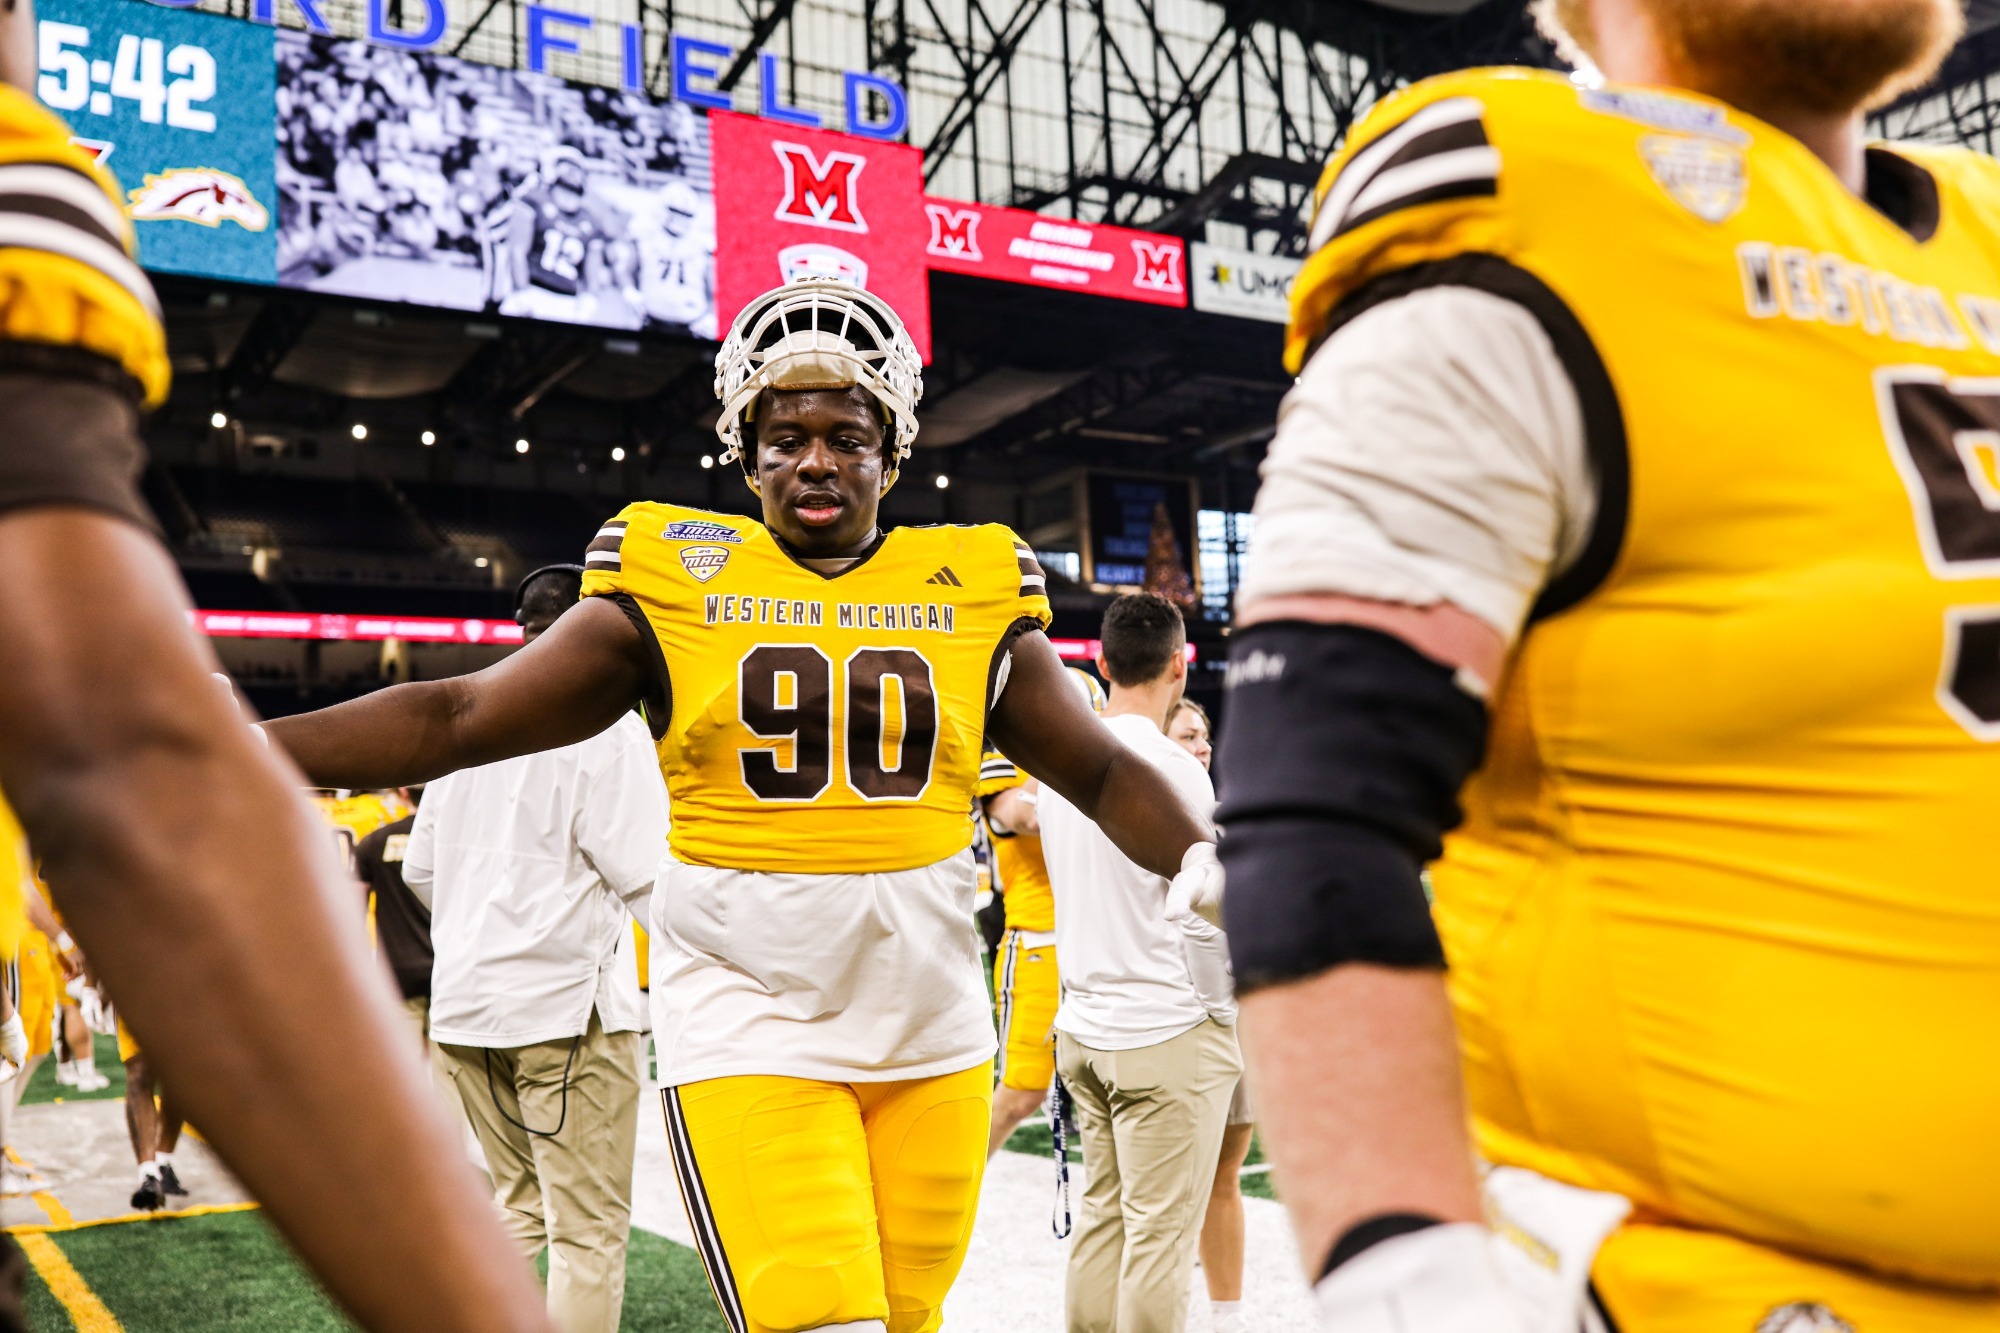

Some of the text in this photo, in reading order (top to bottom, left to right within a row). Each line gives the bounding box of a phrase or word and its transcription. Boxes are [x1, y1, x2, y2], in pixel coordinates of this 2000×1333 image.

[38, 20, 217, 132] 5:42
[527, 4, 908, 139] FIELD
[772, 140, 869, 234] M
[664, 532, 742, 543] CHAMPIONSHIP
[682, 525, 733, 536] MAC
[684, 556, 727, 568] MAC
[704, 594, 955, 634] WESTERN MICHIGAN
[737, 643, 940, 802] 90
